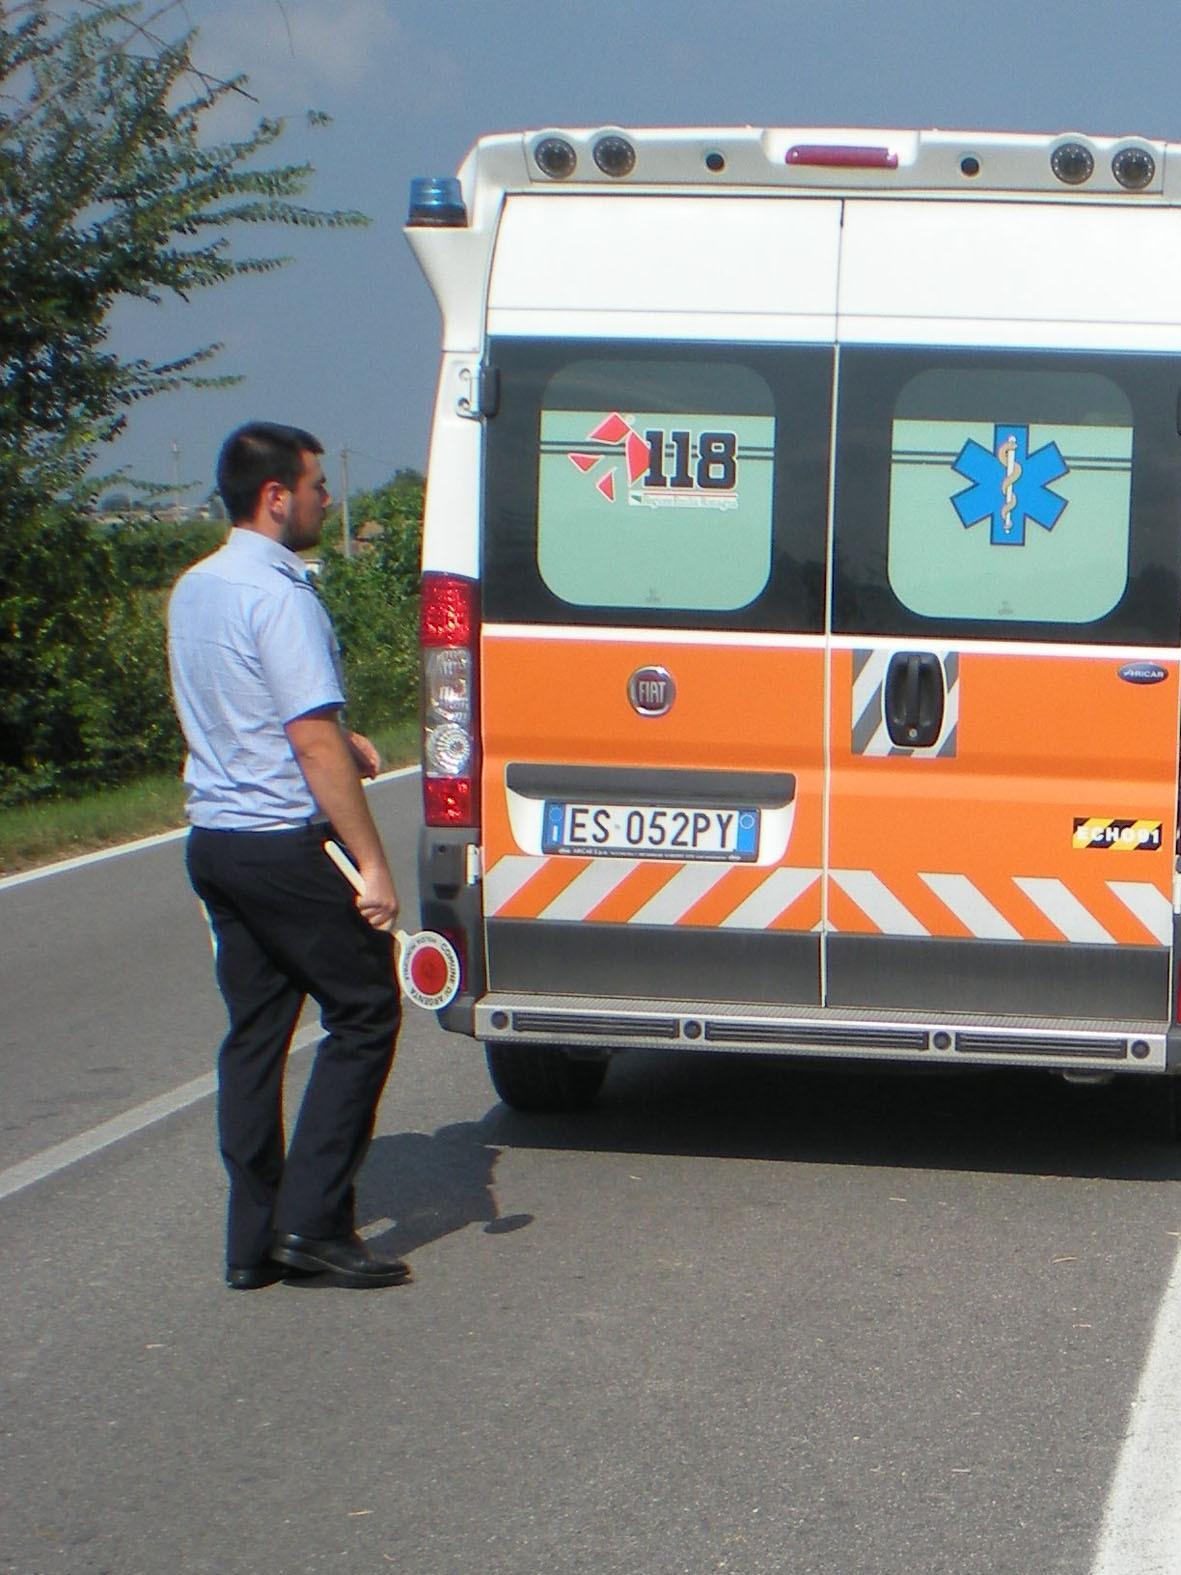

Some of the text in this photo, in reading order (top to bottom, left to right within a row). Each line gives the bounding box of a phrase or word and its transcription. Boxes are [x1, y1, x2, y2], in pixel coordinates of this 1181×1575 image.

[643, 430, 738, 490] 118
[638, 680, 666, 704] FIAT
[569, 808, 611, 843] ES
